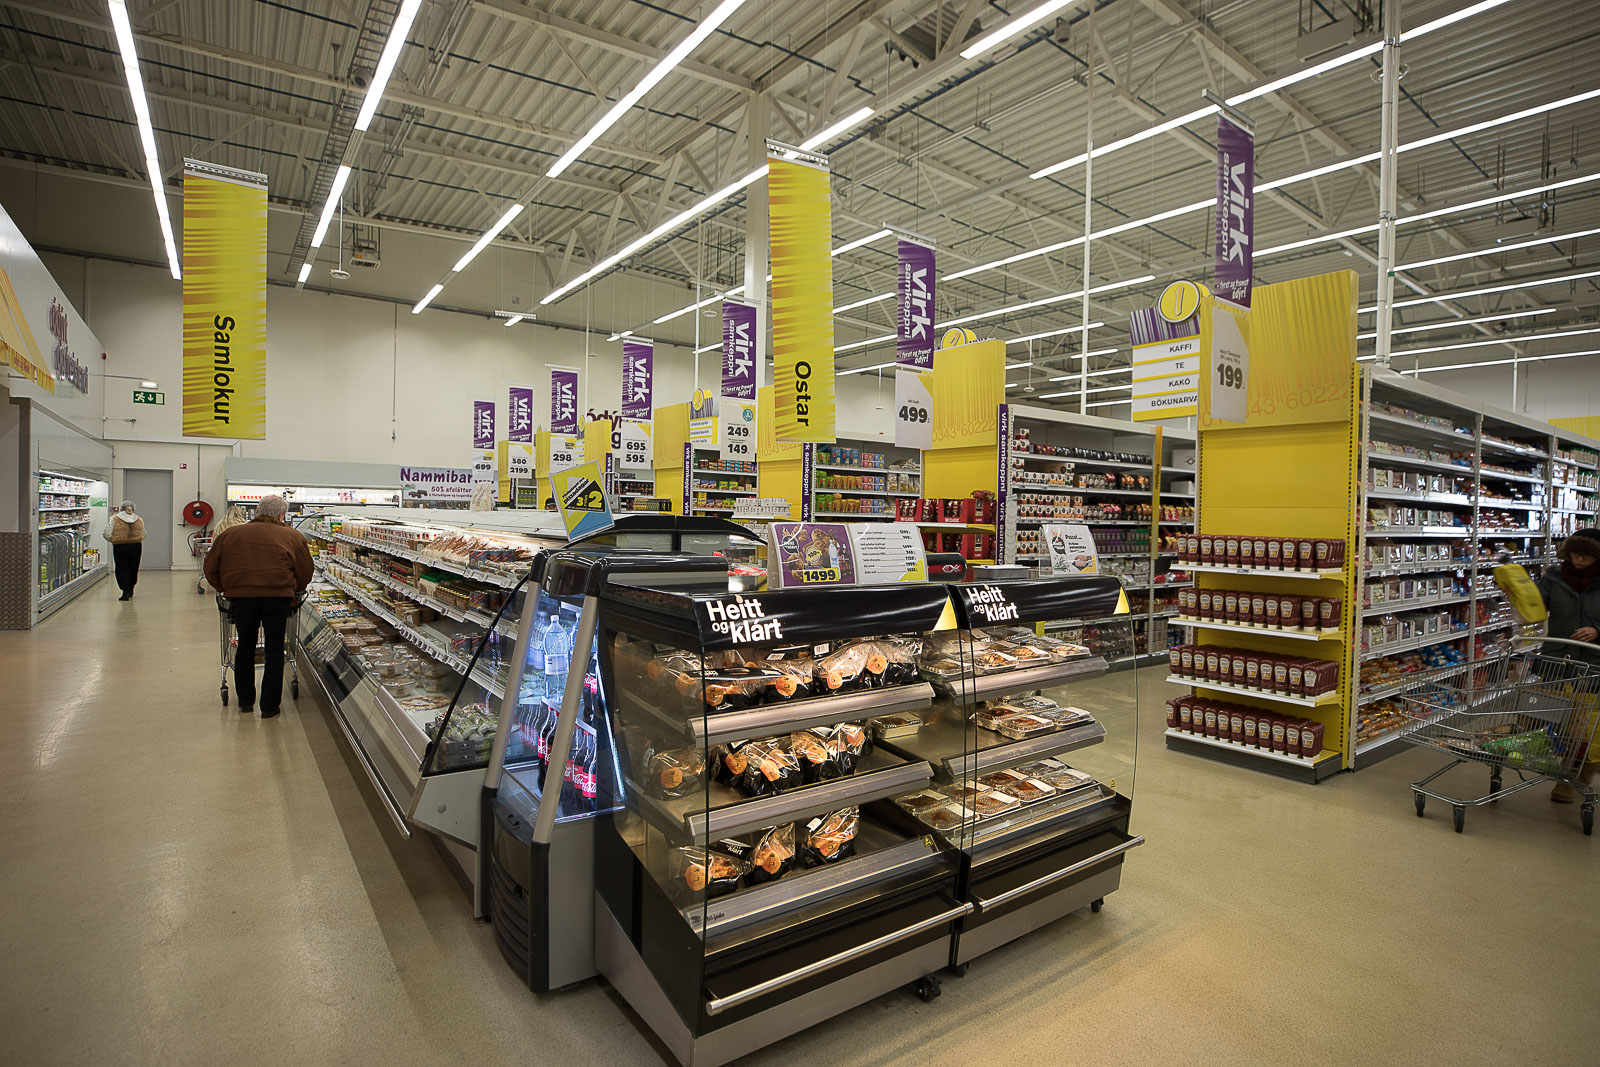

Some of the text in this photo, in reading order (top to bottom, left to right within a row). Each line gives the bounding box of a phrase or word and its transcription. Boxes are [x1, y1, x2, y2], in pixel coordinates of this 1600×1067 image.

[1222, 152, 1230, 262] samkeppni
[1230, 162, 1249, 267] virk
[912, 268, 932, 341] virk
[735, 322, 753, 379] virk
[1170, 344, 1192, 352] KAFFI
[214, 314, 235, 424] Samlokur
[634, 358, 650, 403] virk
[1169, 377, 1190, 387] KAKÓ
[561, 382, 575, 421] virk
[795, 361, 812, 426] Ostar
[482, 410, 493, 439] virk
[518, 397, 530, 431] virk
[576, 497, 584, 507] 3
[588, 490, 603, 508] 2
[706, 595, 765, 621] Heitt
[966, 585, 1006, 604] Heitt
[974, 604, 985, 614] og
[984, 602, 1019, 621] klárt
[712, 621, 729, 634] og
[729, 618, 783, 644] klárt
